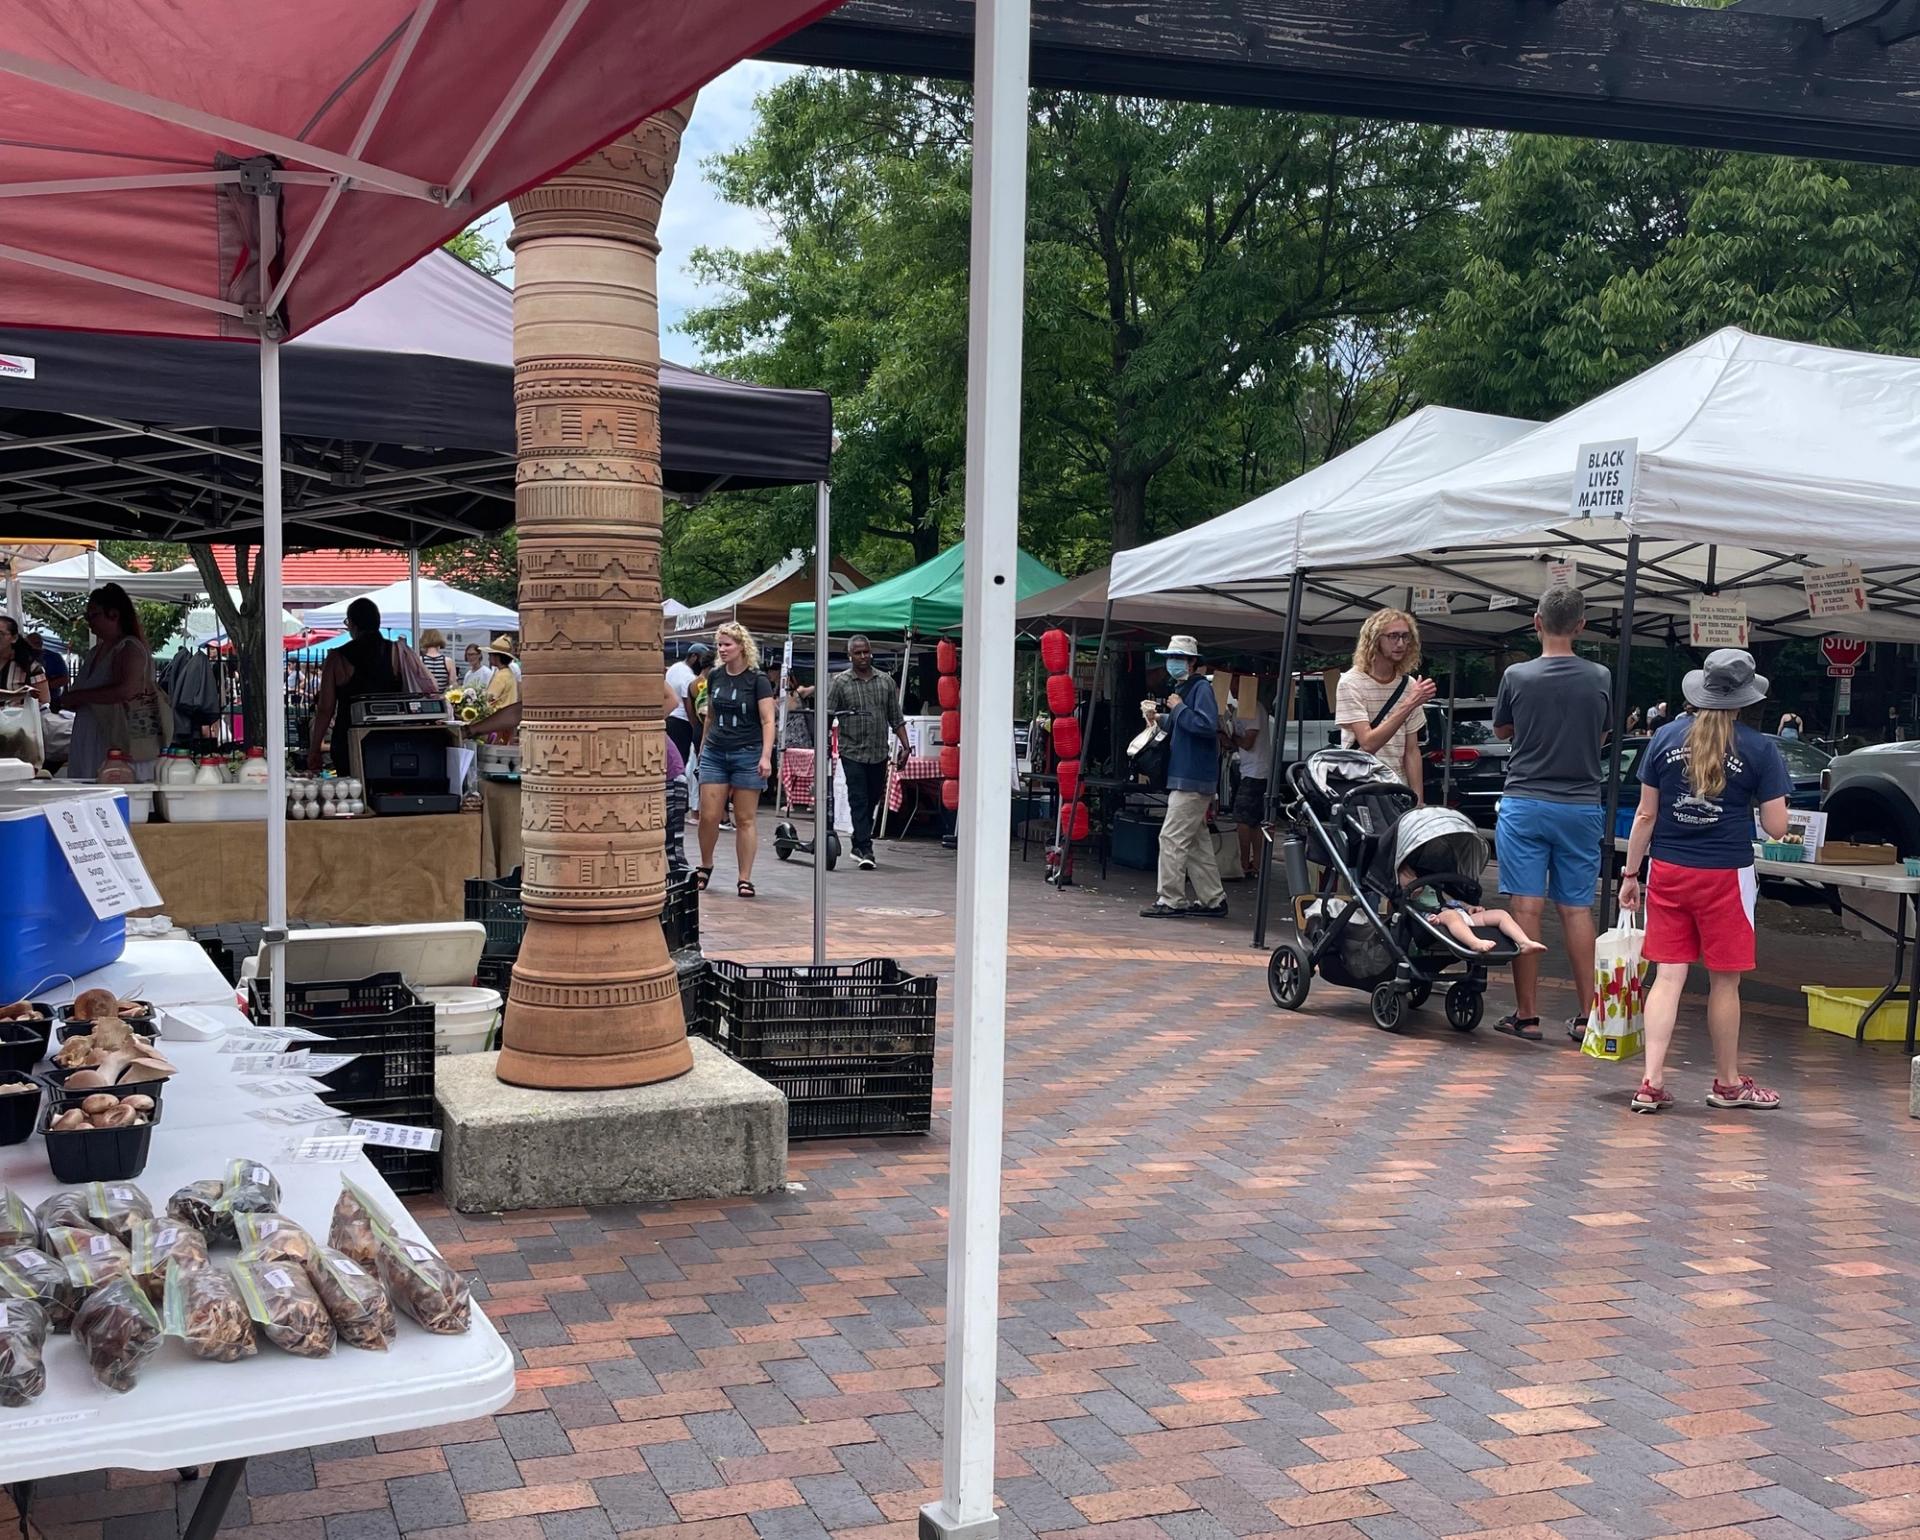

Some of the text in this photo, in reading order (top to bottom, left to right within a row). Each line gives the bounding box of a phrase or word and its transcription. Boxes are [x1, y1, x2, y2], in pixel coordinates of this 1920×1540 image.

[1588, 450, 1625, 469] BLACK
[1588, 470, 1620, 488] LIVES
[1578, 490, 1624, 507] MATTER
[1825, 637, 1863, 650] STOP
[1726, 761, 1743, 773] TOP
[65, 838, 97, 851] Hungarian
[72, 852, 106, 865] Mushroom
[87, 867, 104, 877] Soup
